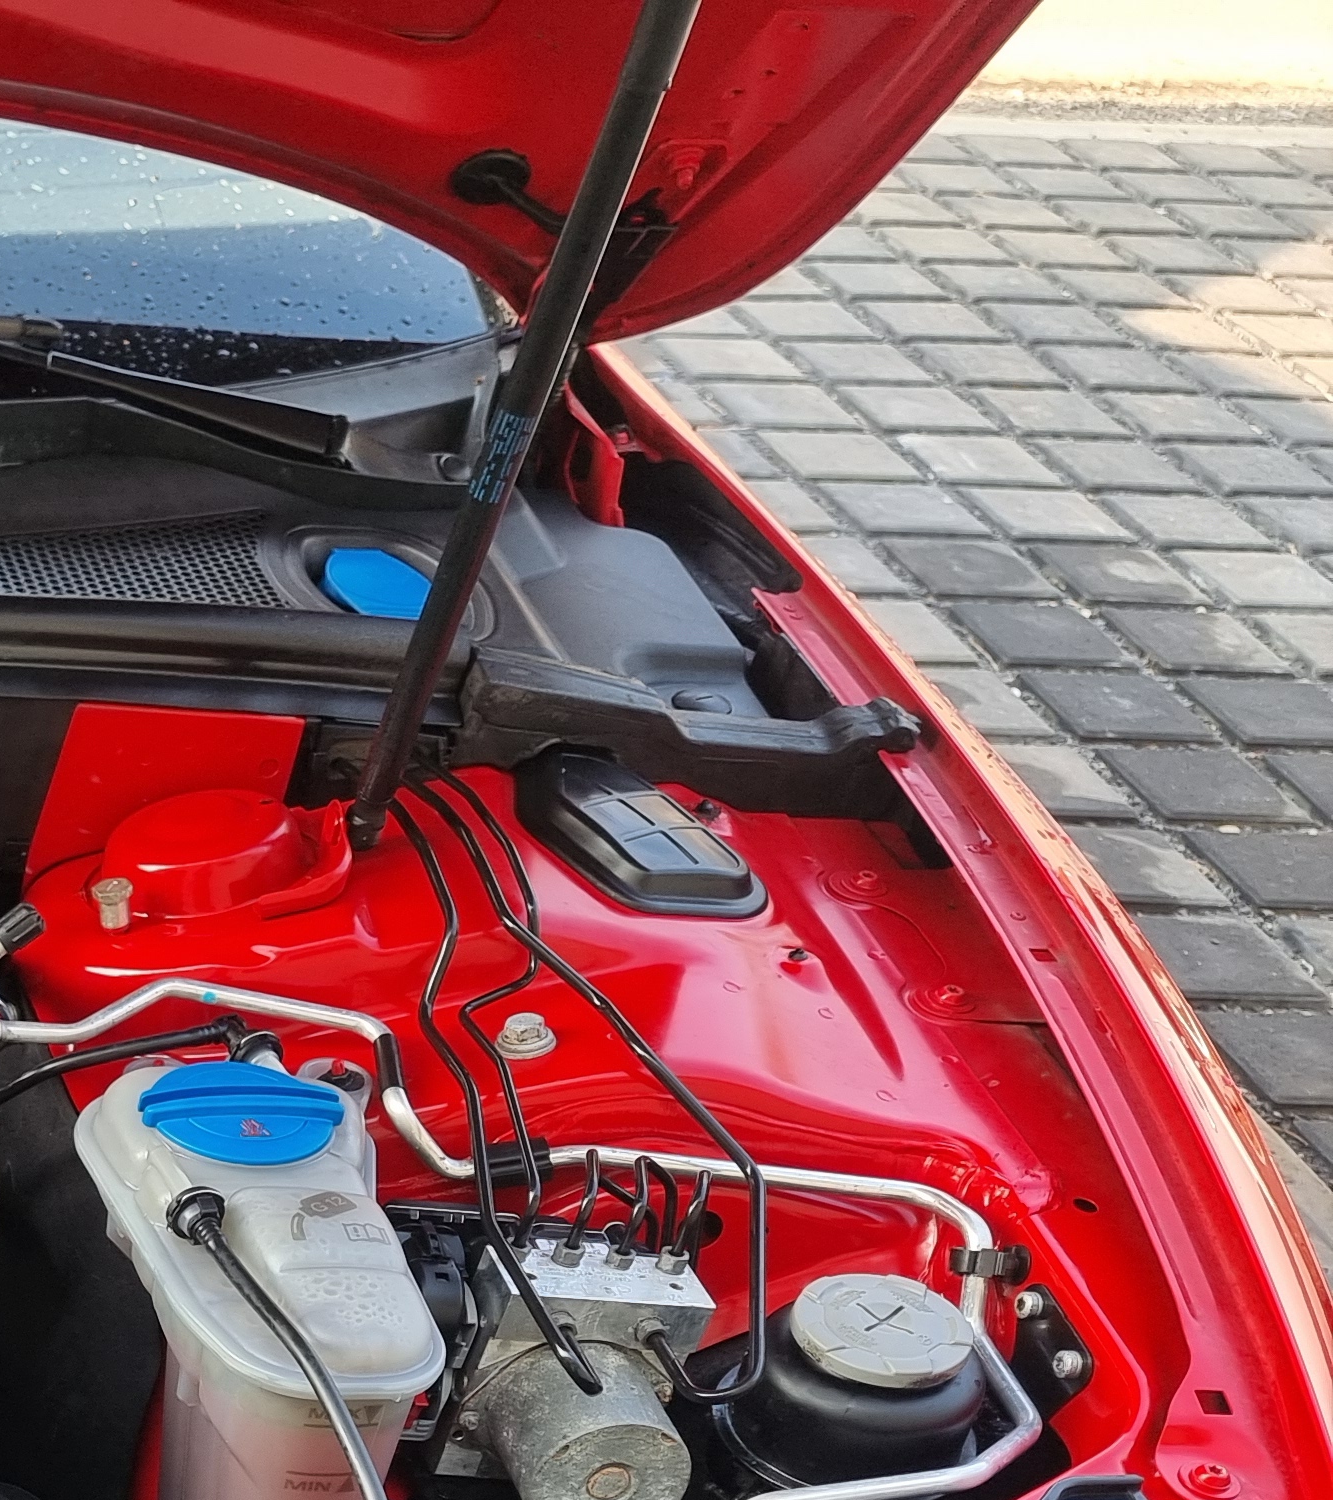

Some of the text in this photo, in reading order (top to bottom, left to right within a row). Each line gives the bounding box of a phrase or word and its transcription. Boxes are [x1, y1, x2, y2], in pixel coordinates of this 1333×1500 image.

[310, 1196, 348, 1213] G 12
[307, 1407, 363, 1420] MX
[284, 1479, 332, 1492] MIN
